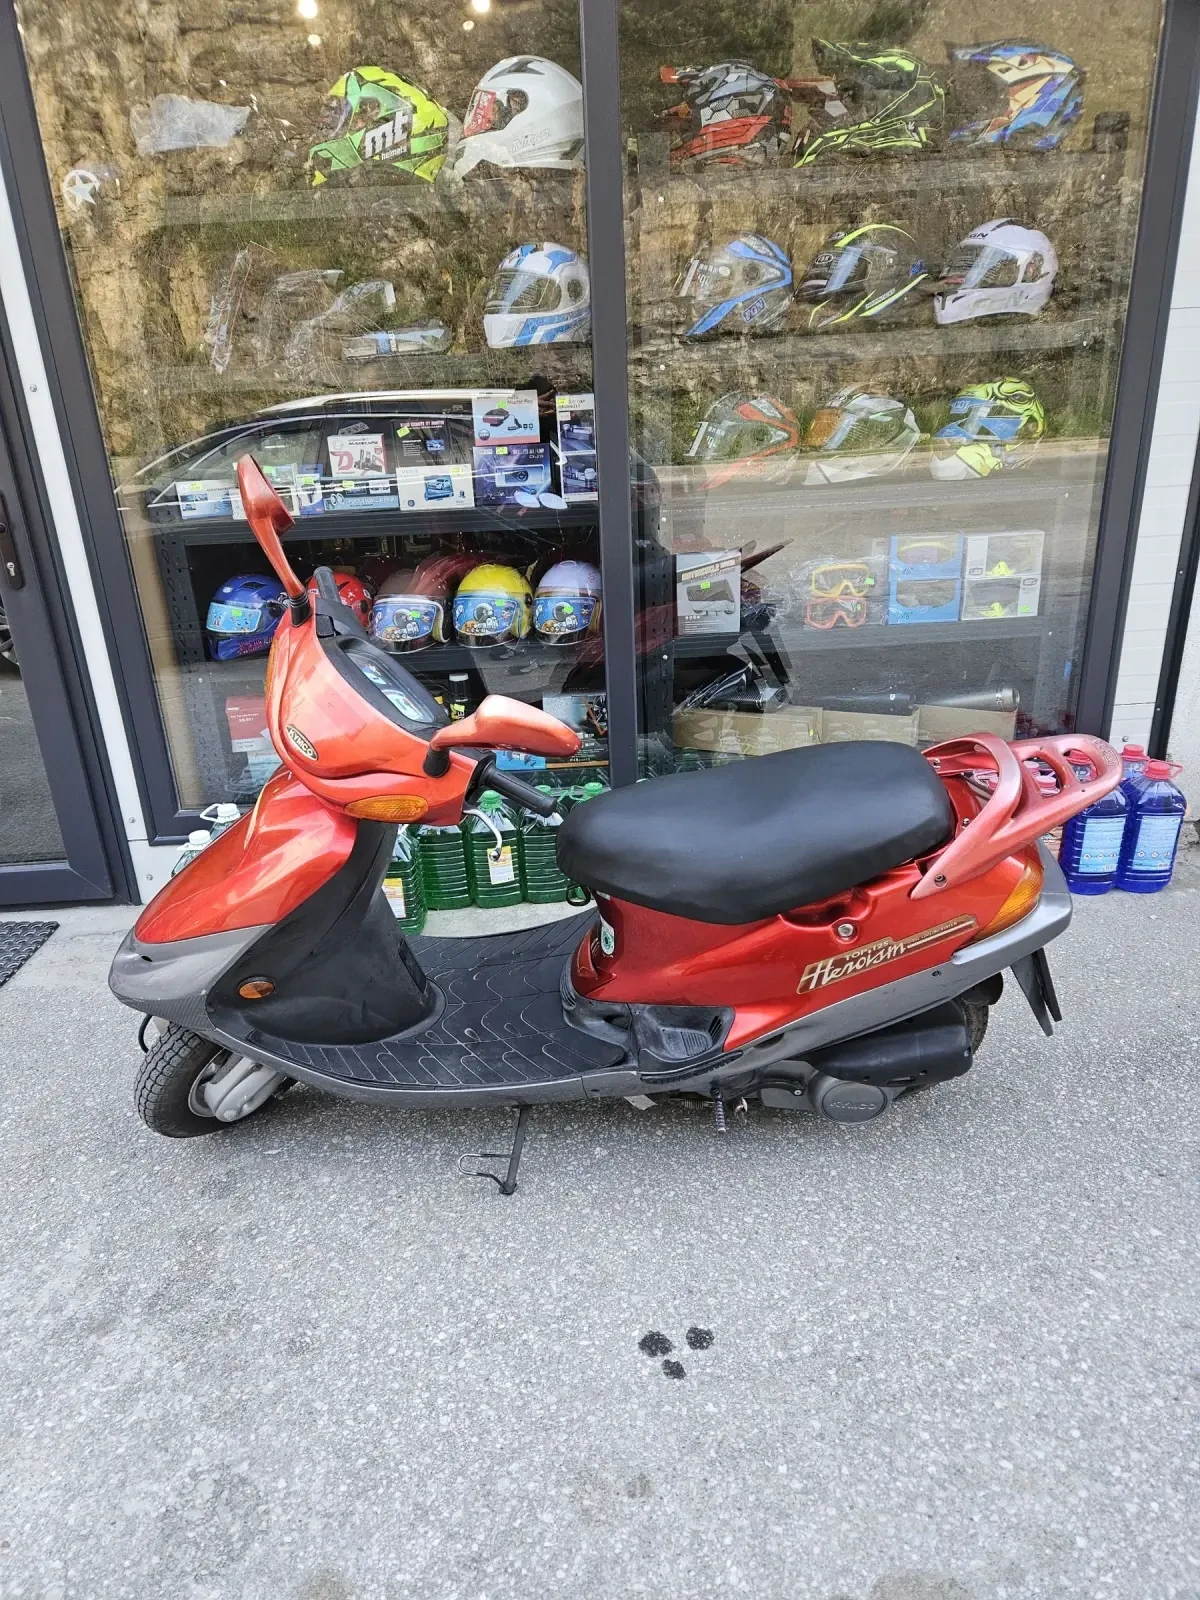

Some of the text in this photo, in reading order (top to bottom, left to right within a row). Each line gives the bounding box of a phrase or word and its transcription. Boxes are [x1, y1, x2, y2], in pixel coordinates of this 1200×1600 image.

[381, 145, 408, 160] helmets
[288, 728, 314, 757] KYMCO
[802, 942, 907, 990] Heroism
